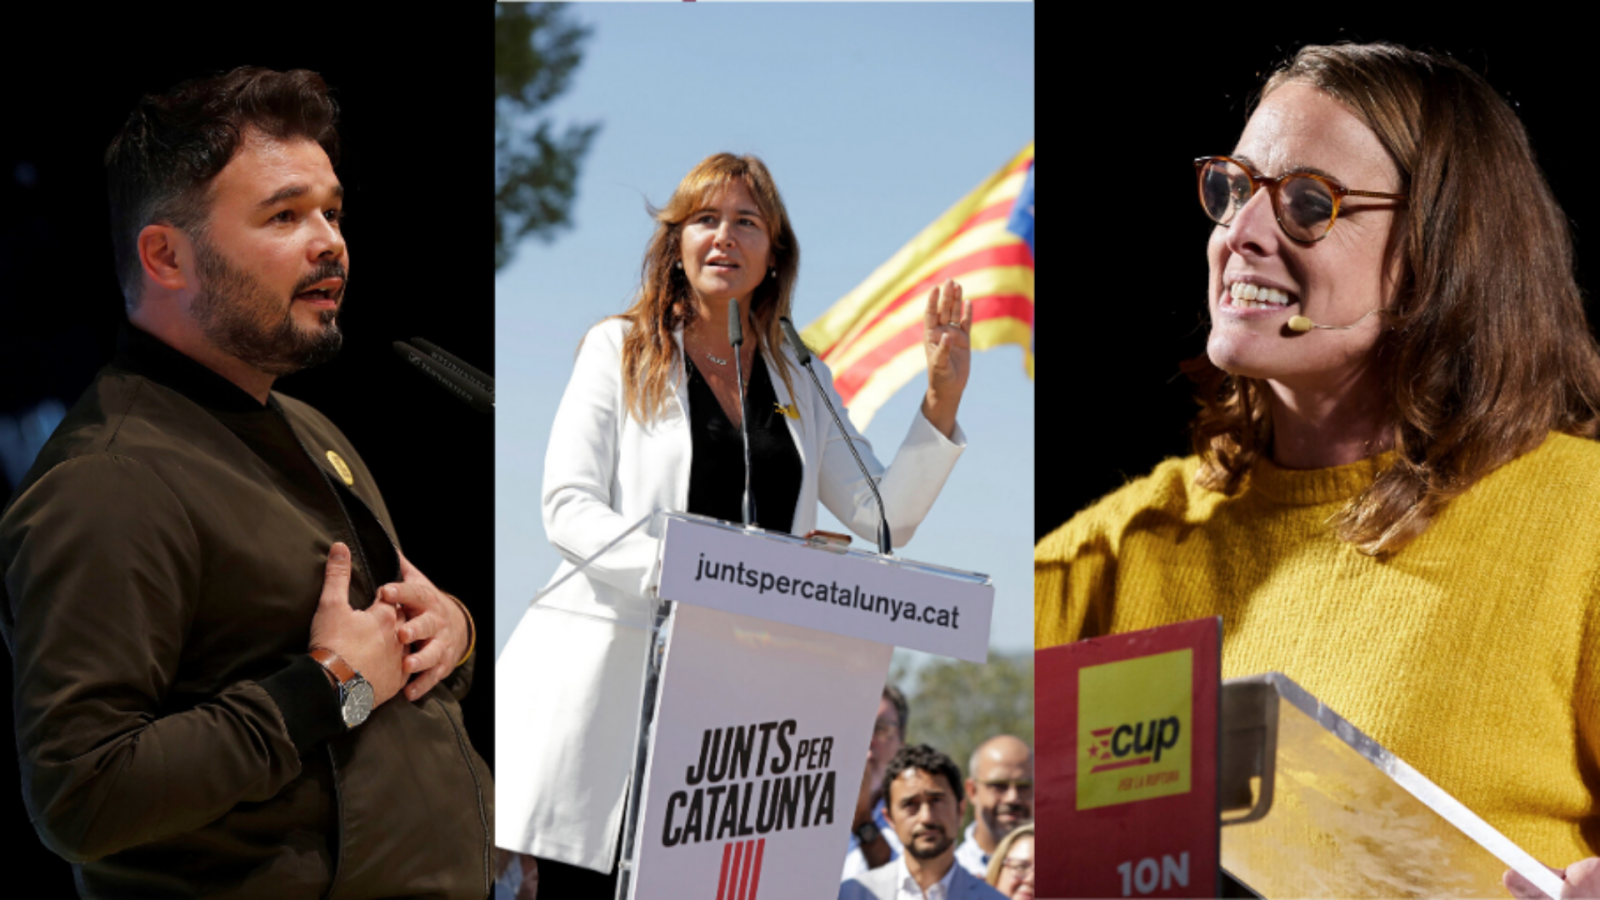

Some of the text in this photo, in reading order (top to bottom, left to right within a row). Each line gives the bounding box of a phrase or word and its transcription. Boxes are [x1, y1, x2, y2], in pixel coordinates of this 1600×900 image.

[695, 553, 960, 629] juntspercatalunya.cat
[686, 719, 834, 786] JUNTS PER
[1111, 715, 1180, 763] cup
[662, 771, 836, 848] CATALUNYA
[1117, 851, 1189, 897] 10N
